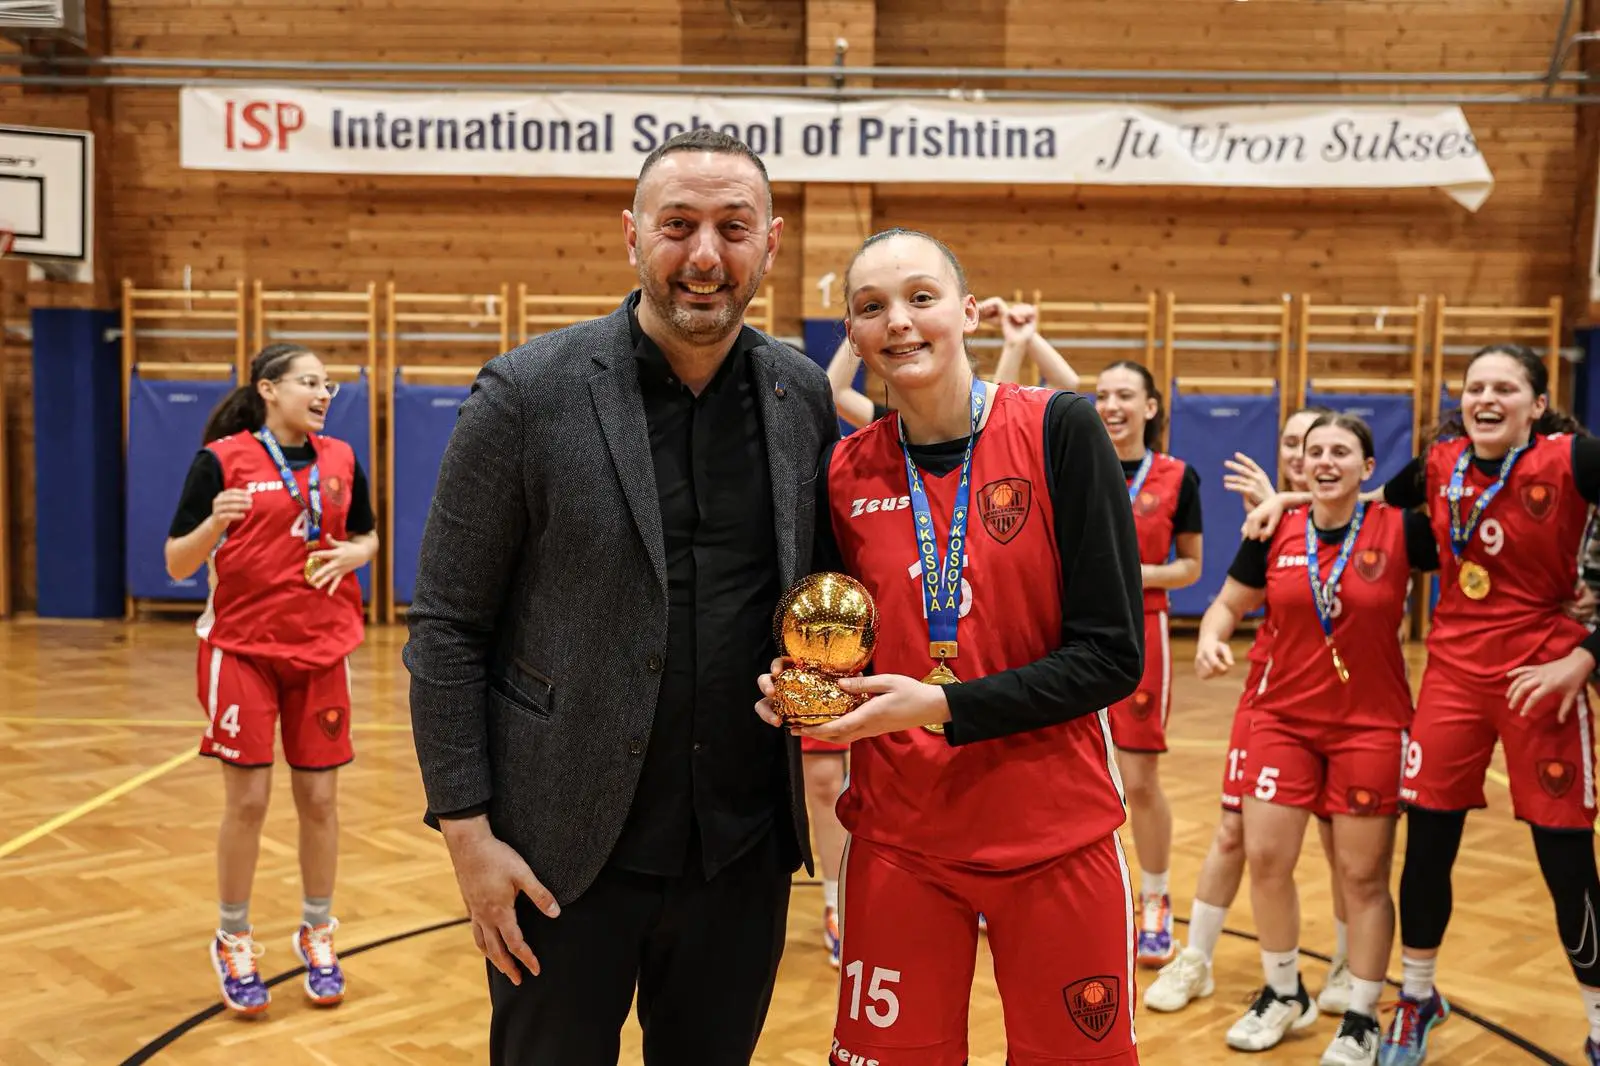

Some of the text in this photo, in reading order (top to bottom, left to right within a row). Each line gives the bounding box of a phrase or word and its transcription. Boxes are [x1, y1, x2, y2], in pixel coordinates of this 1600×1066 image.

[224, 101, 304, 153] ISP
[332, 108, 614, 153] International
[802, 116, 842, 157] of
[859, 117, 1057, 159] Prishtina
[1096, 116, 1160, 172] Ju
[290, 508, 310, 541] 4
[849, 495, 911, 518] Zeus
[1480, 518, 1505, 556] 9
[920, 528, 942, 612] KOSOVA
[944, 524, 963, 609] KOSOVA
[1276, 554, 1309, 568] Zeu
[220, 704, 241, 739] 4
[1405, 741, 1423, 779] 9
[1255, 766, 1280, 801] 5
[845, 959, 901, 1029] 15
